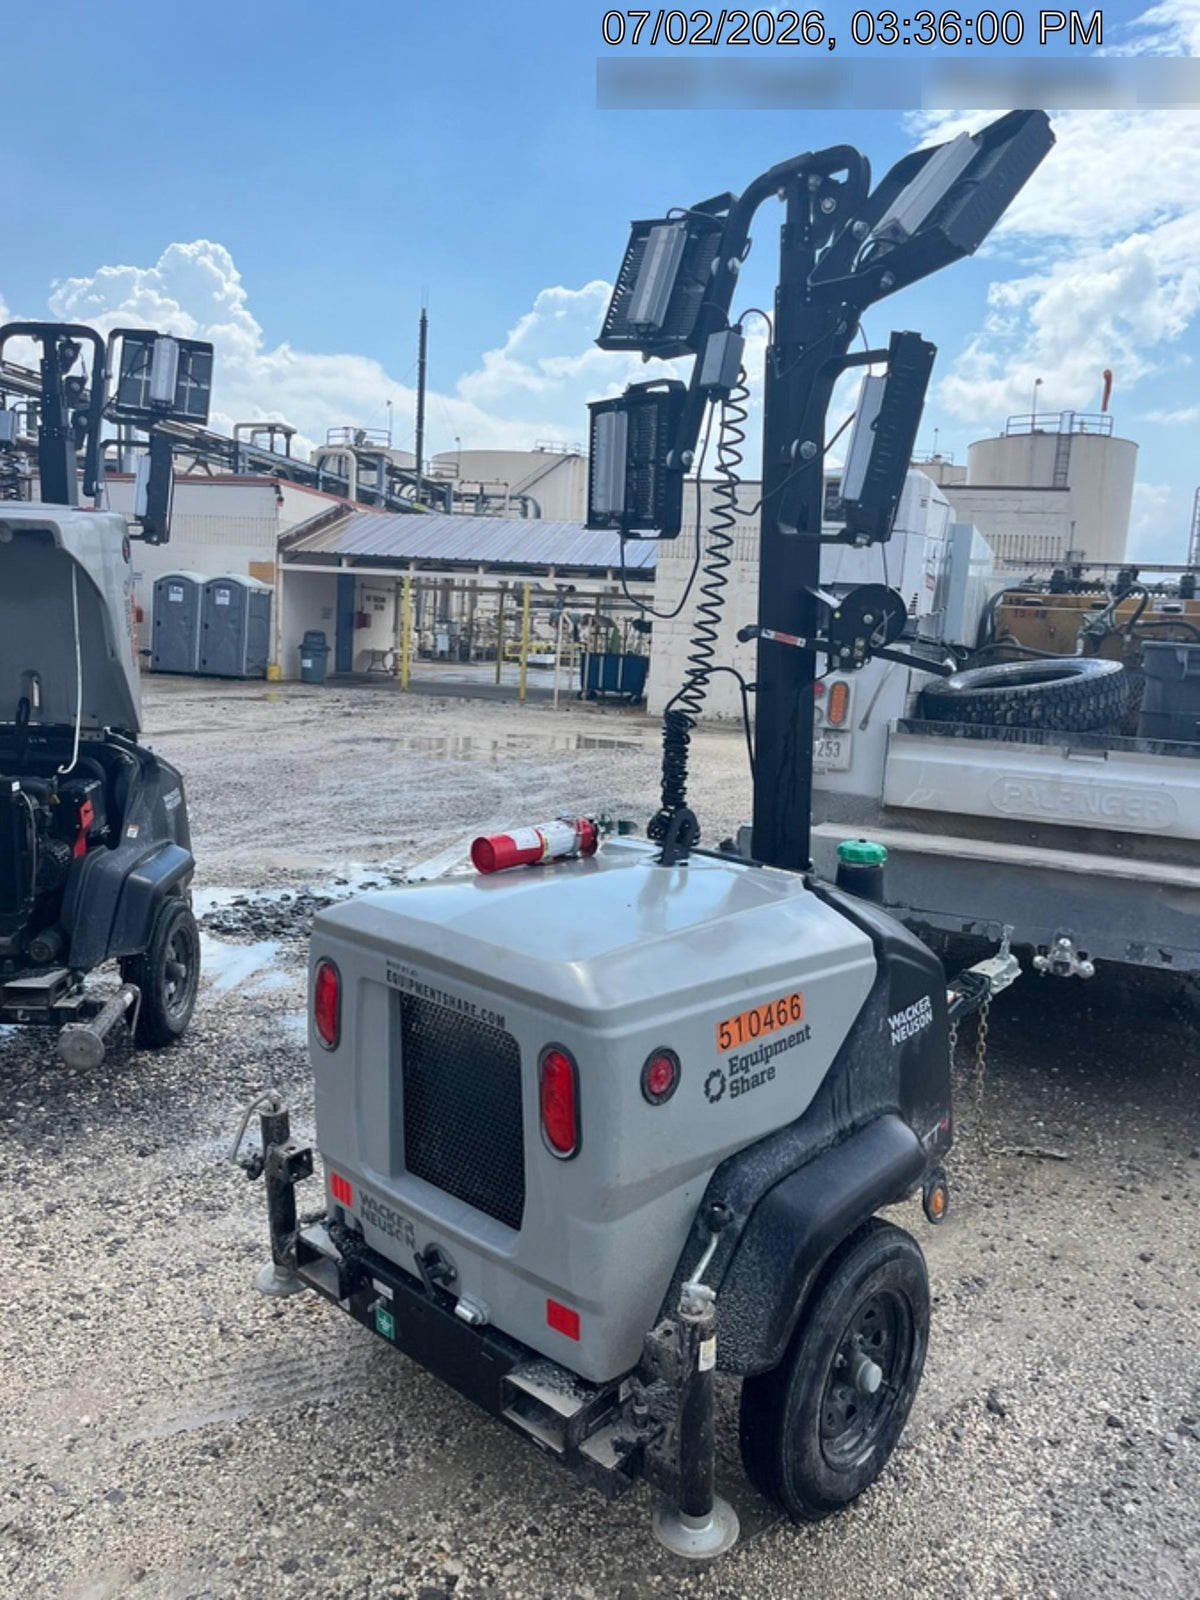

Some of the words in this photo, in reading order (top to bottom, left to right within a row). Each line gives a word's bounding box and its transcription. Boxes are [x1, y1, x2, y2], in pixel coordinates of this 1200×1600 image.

[815, 739, 842, 758] 253
[719, 994, 802, 1050] 510466
[887, 994, 931, 1030] WACKER
[891, 1007, 933, 1046] NEUSON
[728, 1023, 812, 1077] Equipment
[729, 1066, 776, 1099] Share
[359, 1190, 415, 1233] WACKER
